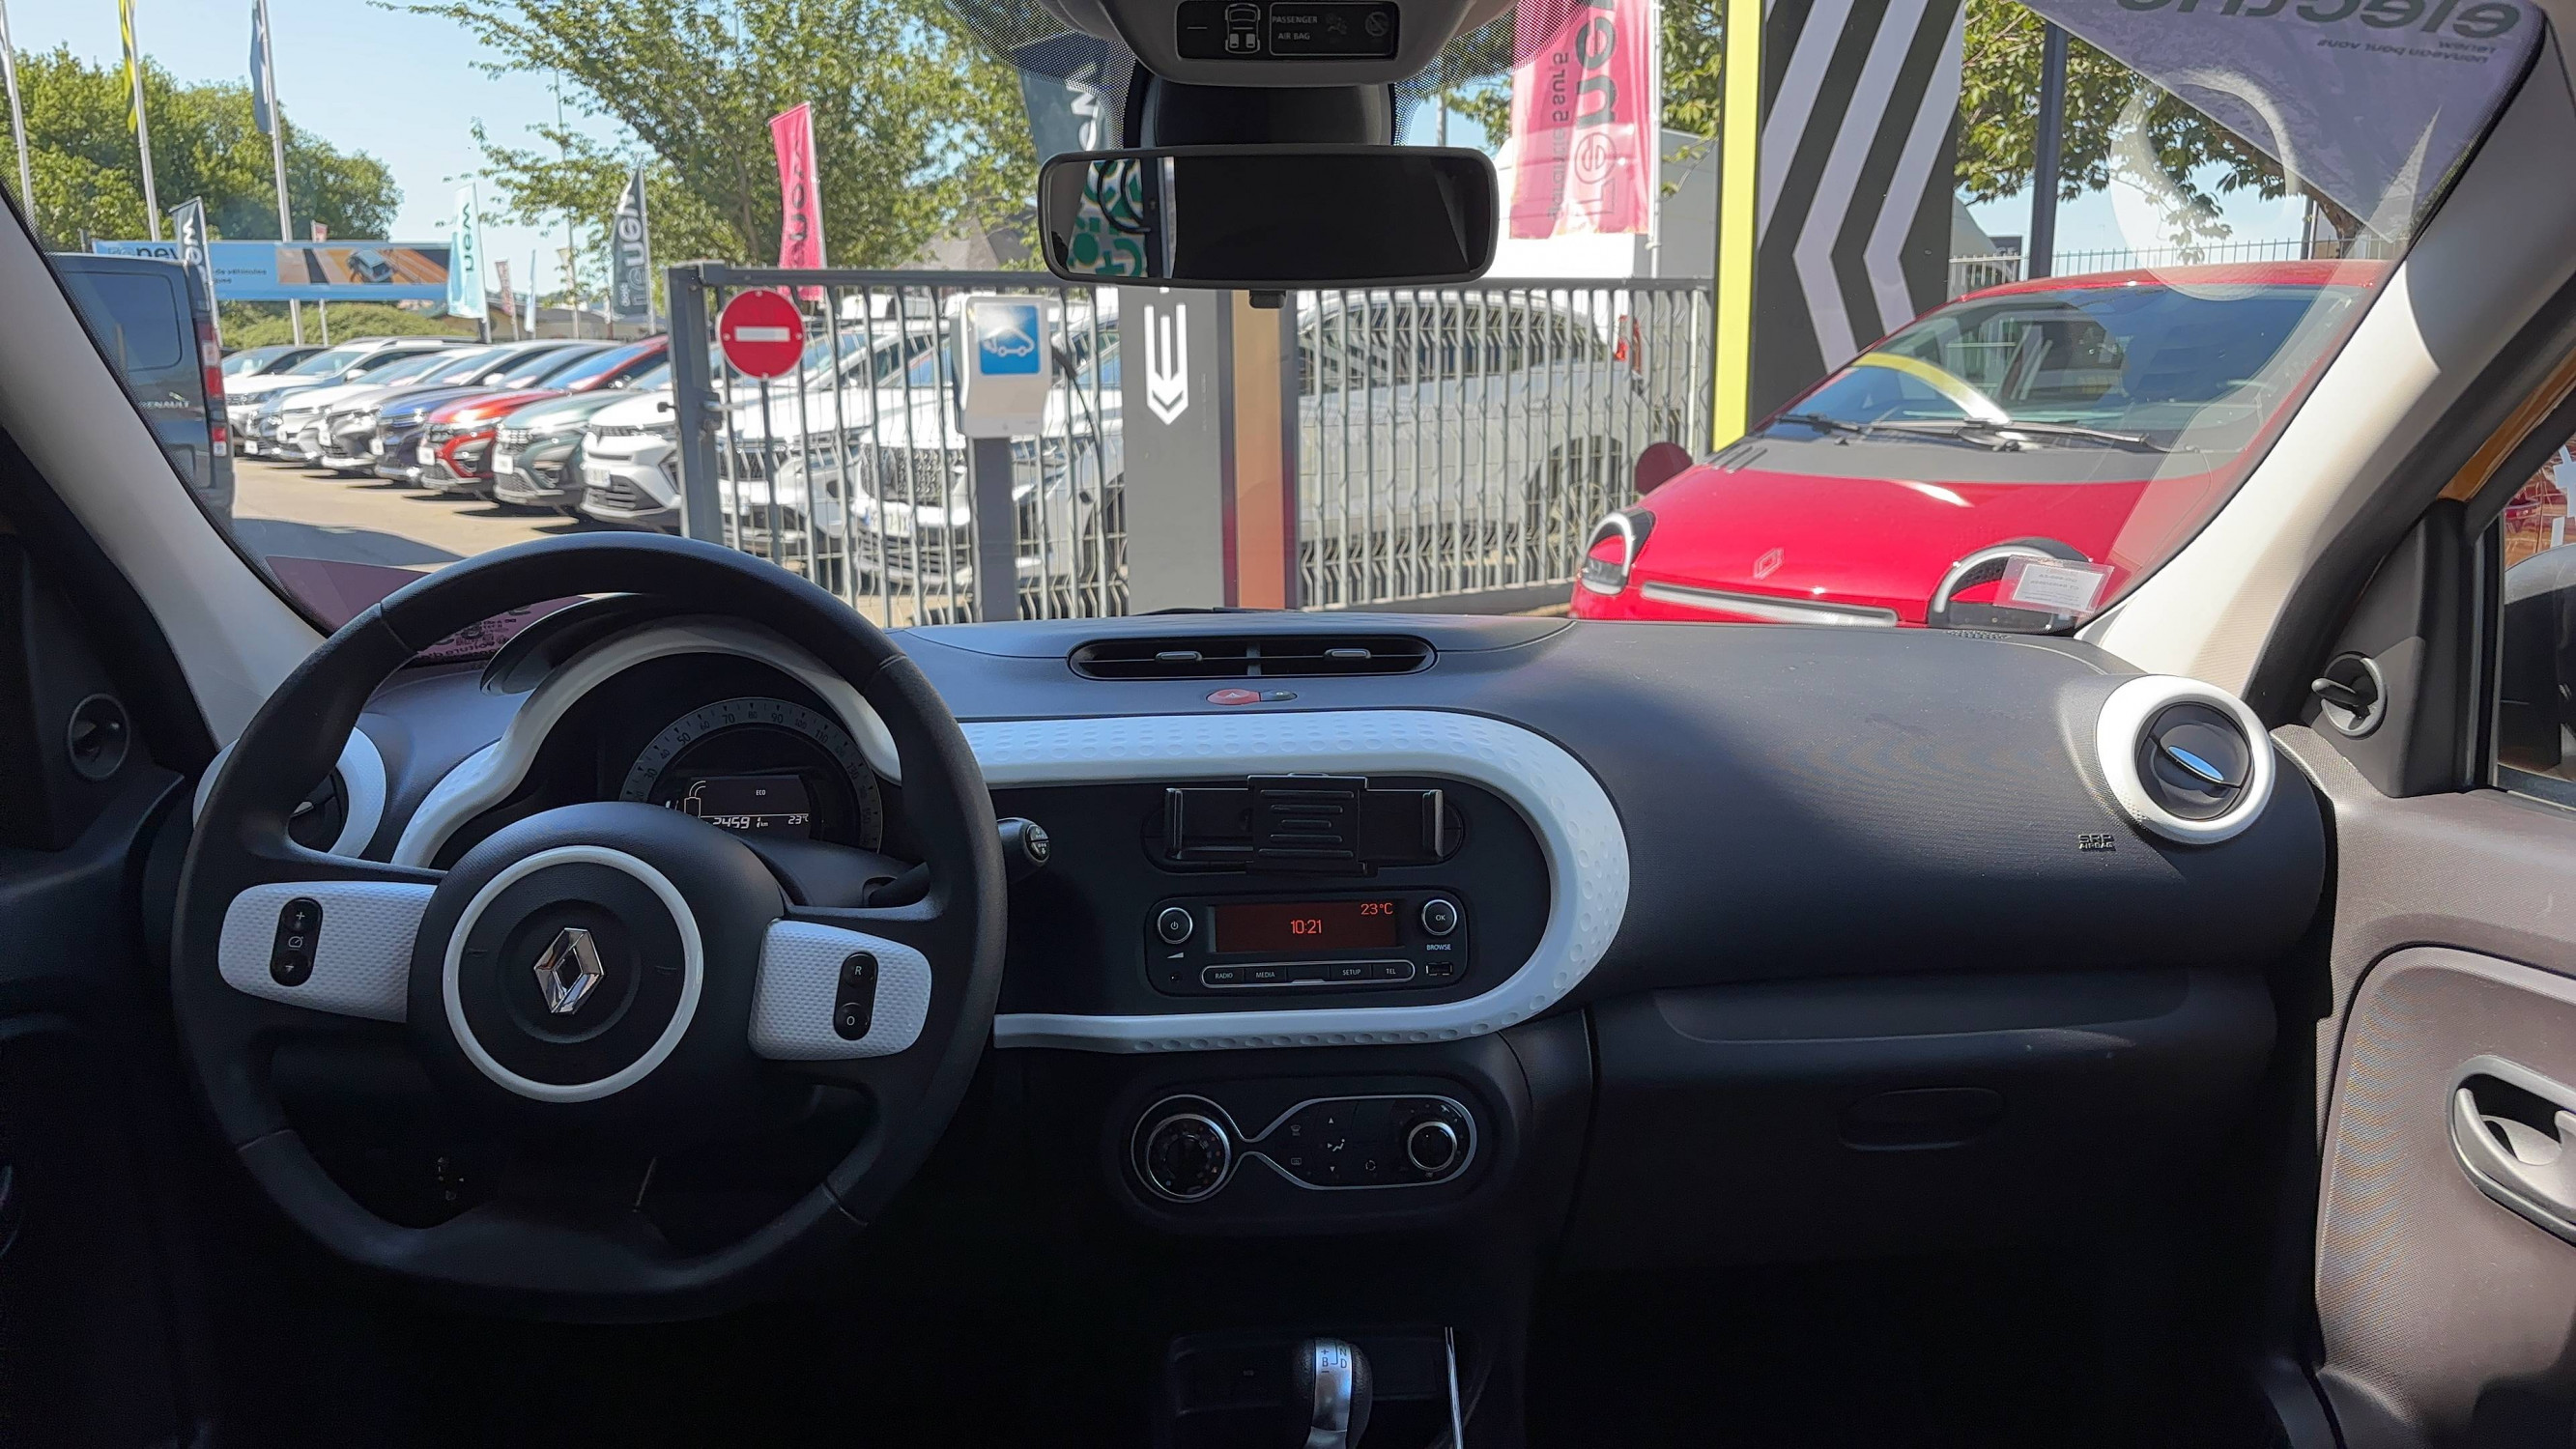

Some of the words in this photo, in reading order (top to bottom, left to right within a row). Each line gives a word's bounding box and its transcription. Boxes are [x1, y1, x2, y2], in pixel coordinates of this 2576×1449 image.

[1272, 15, 1318, 24] PASSENGER
[1278, 32, 1291, 41] AIR
[1294, 32, 1310, 41] BAG
[722, 713, 735, 724] 70
[747, 711, 758, 720] 80
[771, 713, 784, 724] 90
[700, 721, 710, 729] 60
[794, 717, 807, 729] 100
[676, 731, 692, 745] 50
[815, 728, 829, 744] 110
[660, 748, 671, 760] 40
[644, 767, 658, 781] 30
[2079, 841, 2114, 850] AIRBAG
[1360, 903, 1393, 915] 23°C
[1290, 919, 1322, 934] 10:21
[854, 966, 862, 976] R
[1340, 1348, 1347, 1356] N
[1322, 1356, 1329, 1367] B
[1340, 1358, 1347, 1369] D
